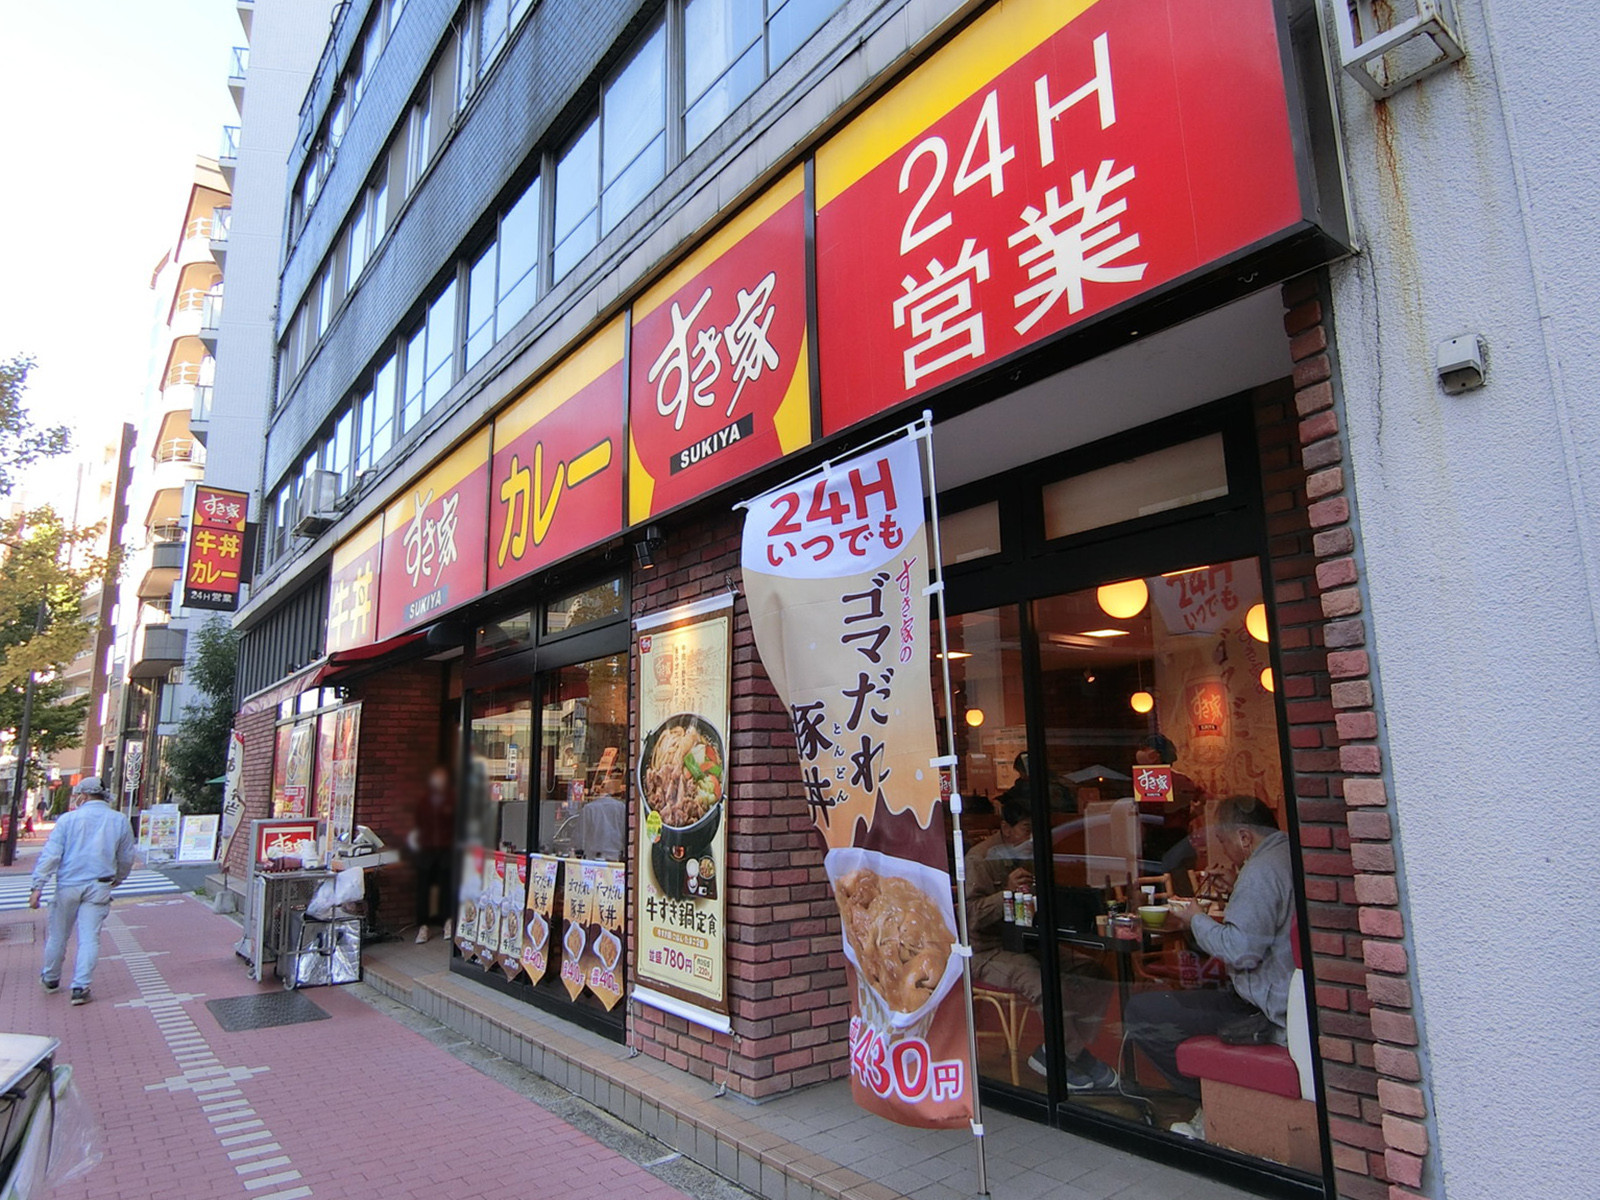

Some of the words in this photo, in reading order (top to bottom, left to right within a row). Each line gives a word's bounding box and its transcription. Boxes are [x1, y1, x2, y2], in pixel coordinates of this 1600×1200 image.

[898, 31, 1116, 256] 24H
[893, 159, 1149, 390] 営業
[648, 271, 779, 431] すき家
[680, 422, 741, 470] SUKIYA
[203, 494, 241, 520] すき家
[497, 436, 612, 568] カレー
[767, 458, 898, 537] 24H
[190, 559, 238, 584] カレー
[195, 530, 240, 558] 牛丼
[403, 488, 459, 588] すき家
[767, 514, 904, 567] いつでも
[330, 560, 375, 648] 牛丼
[409, 590, 442, 619] SUKIYA
[895, 556, 918, 664] すき家の
[841, 572, 895, 793] ゴマだれ
[1137, 769, 1169, 793] すき家
[646, 896, 718, 937] 牛すき鍋定食
[853, 1028, 960, 1098] 430円
